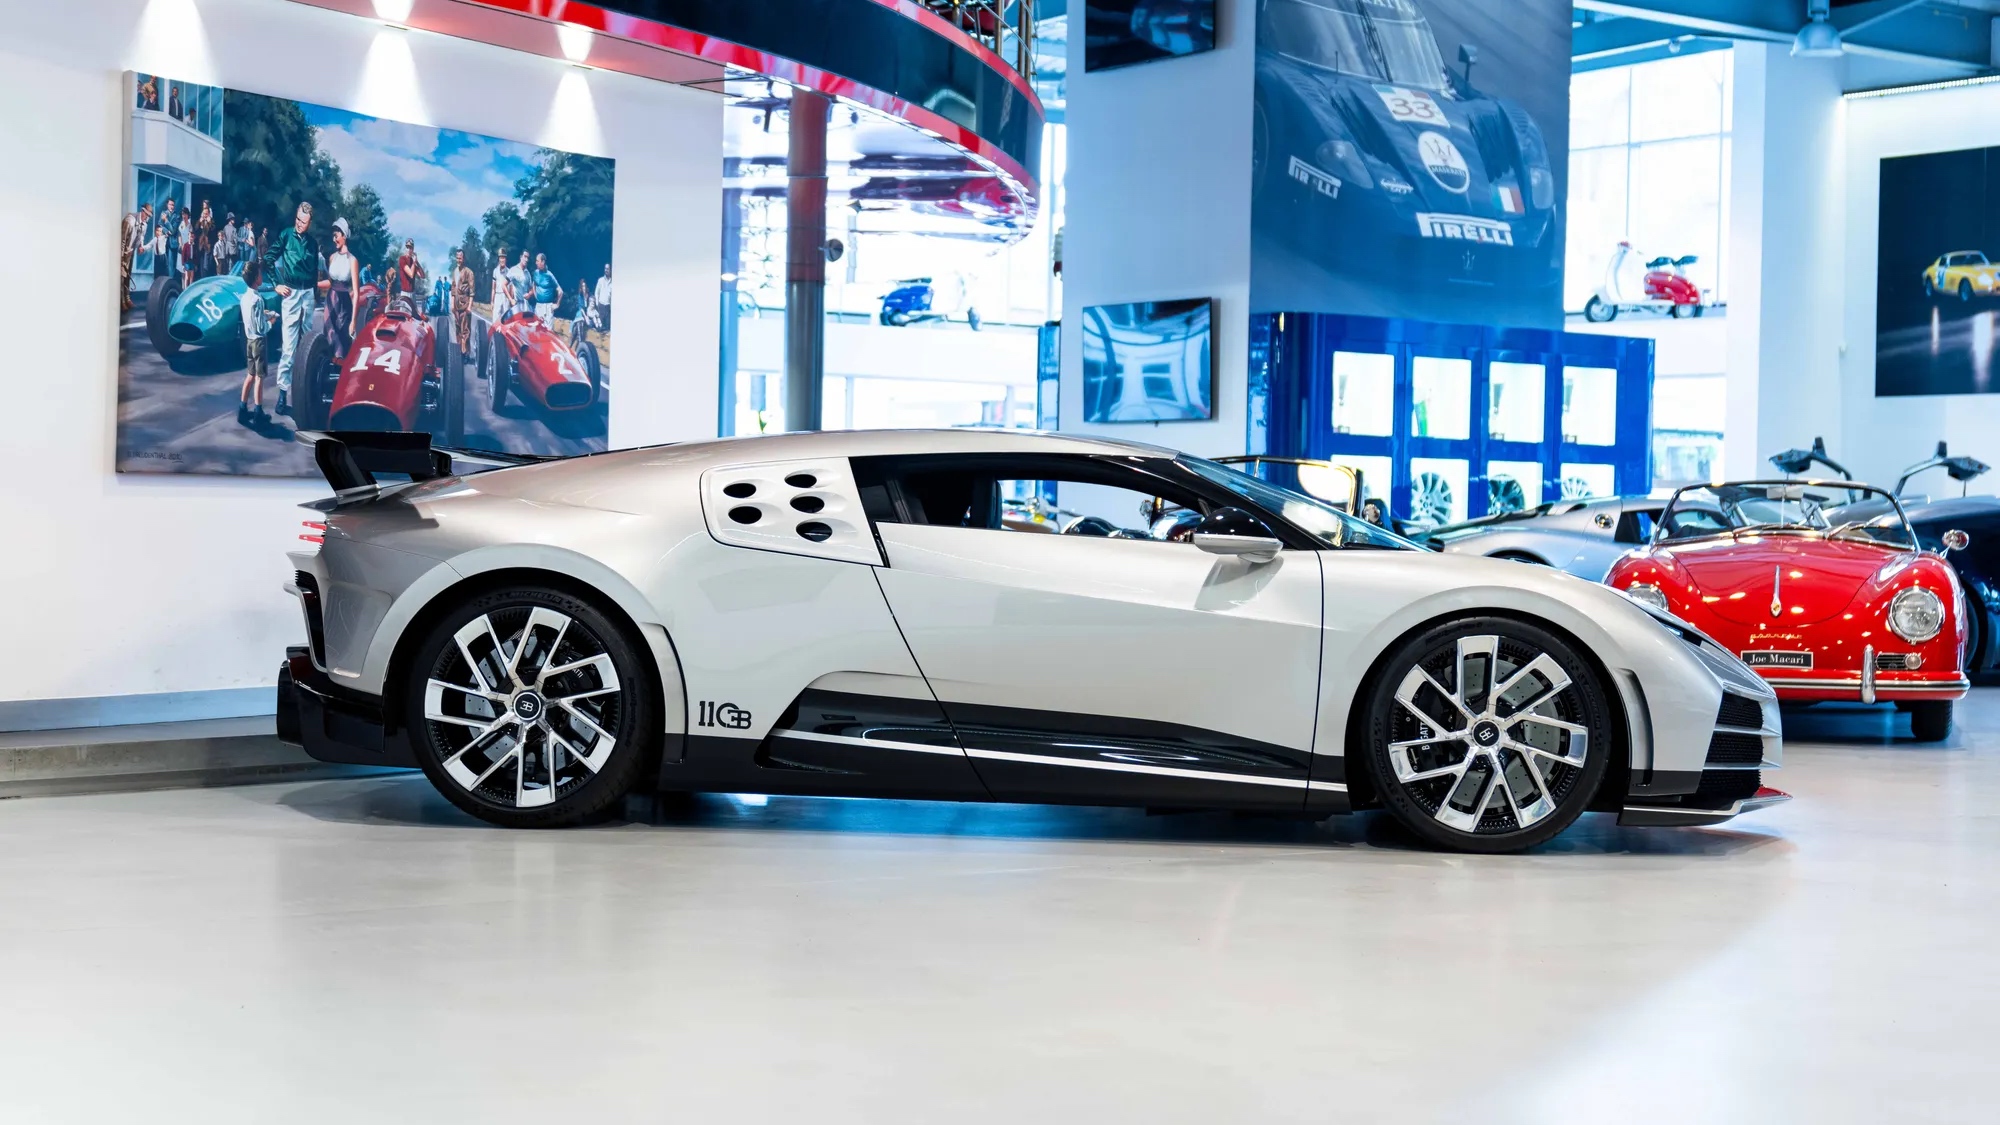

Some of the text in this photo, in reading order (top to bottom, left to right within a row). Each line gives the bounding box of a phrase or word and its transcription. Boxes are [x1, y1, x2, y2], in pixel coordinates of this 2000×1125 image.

[1391, 98, 1435, 119] 33
[1288, 155, 1342, 199] PIRLLI
[1416, 212, 1514, 247] PIRELLI
[195, 298, 222, 322] 18
[349, 346, 402, 376] 14
[1749, 654, 1804, 664] Joe Macari
